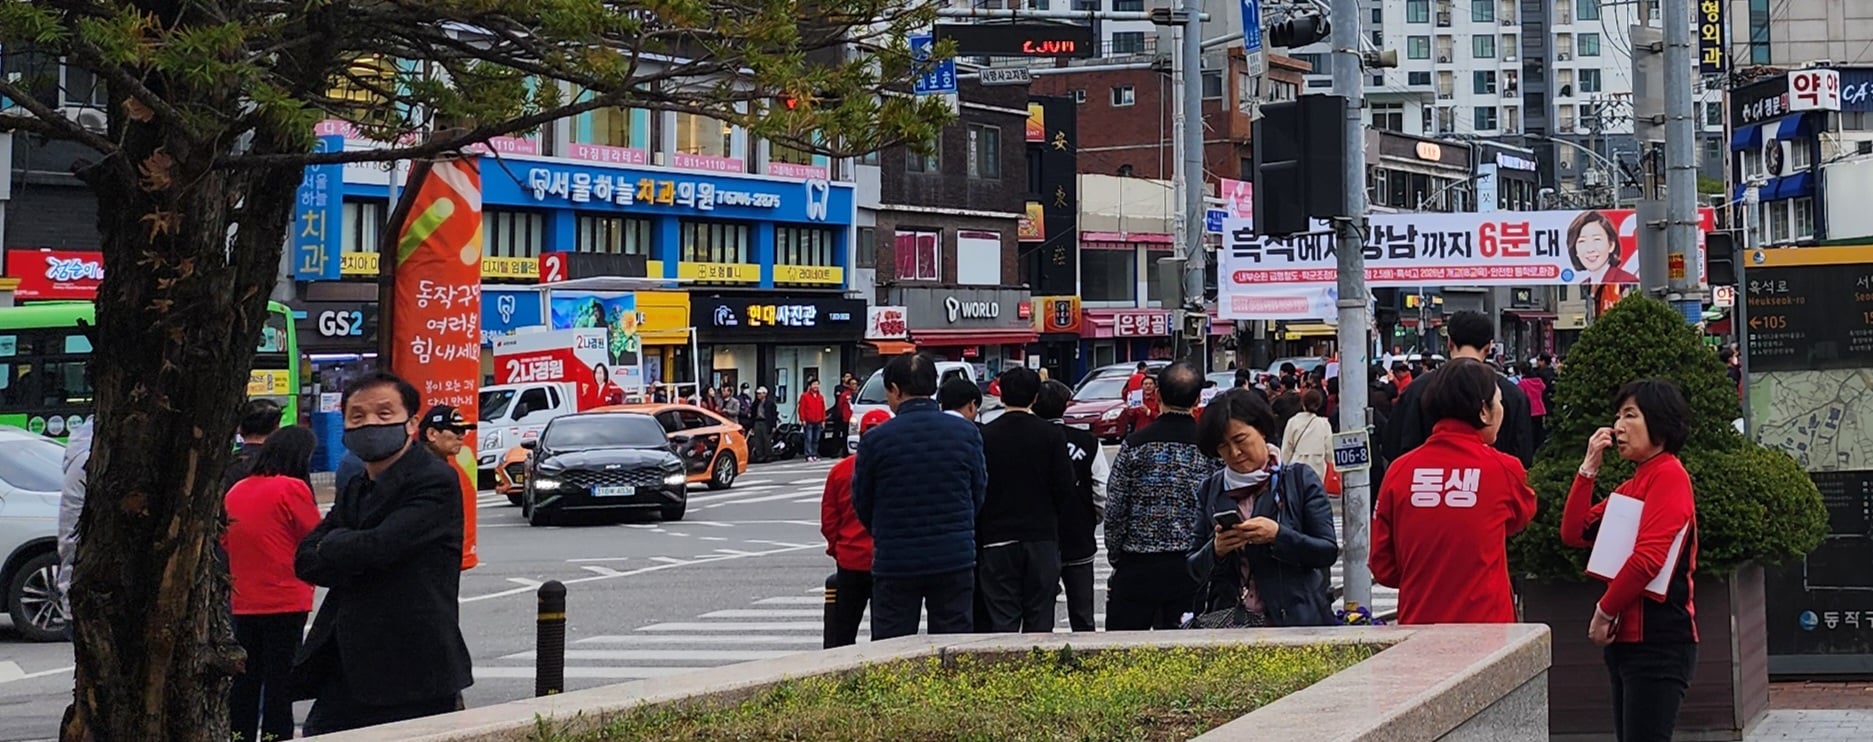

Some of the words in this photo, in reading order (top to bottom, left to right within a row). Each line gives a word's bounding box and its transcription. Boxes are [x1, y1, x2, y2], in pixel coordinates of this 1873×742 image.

[981, 67, 1029, 82] 사망사고지점
[1793, 73, 1821, 106] 약
[683, 158, 726, 171] 811-1110
[550, 170, 716, 211] 서울하늘치과의원
[299, 209, 329, 276] 치과
[511, 261, 538, 274] 임플란
[546, 256, 561, 282] 2
[1856, 275, 1873, 290] 서
[1716, 289, 1733, 305] 약
[1748, 296, 1806, 306] Heukseok-ro
[747, 304, 817, 326] 현대사진관
[961, 302, 999, 318] WORLD
[1120, 315, 1165, 335] 은행골
[1763, 315, 1787, 329] 105
[506, 359, 564, 384] 2나경원
[1336, 448, 1368, 464] 106-8
[1410, 468, 1481, 508] 동생
